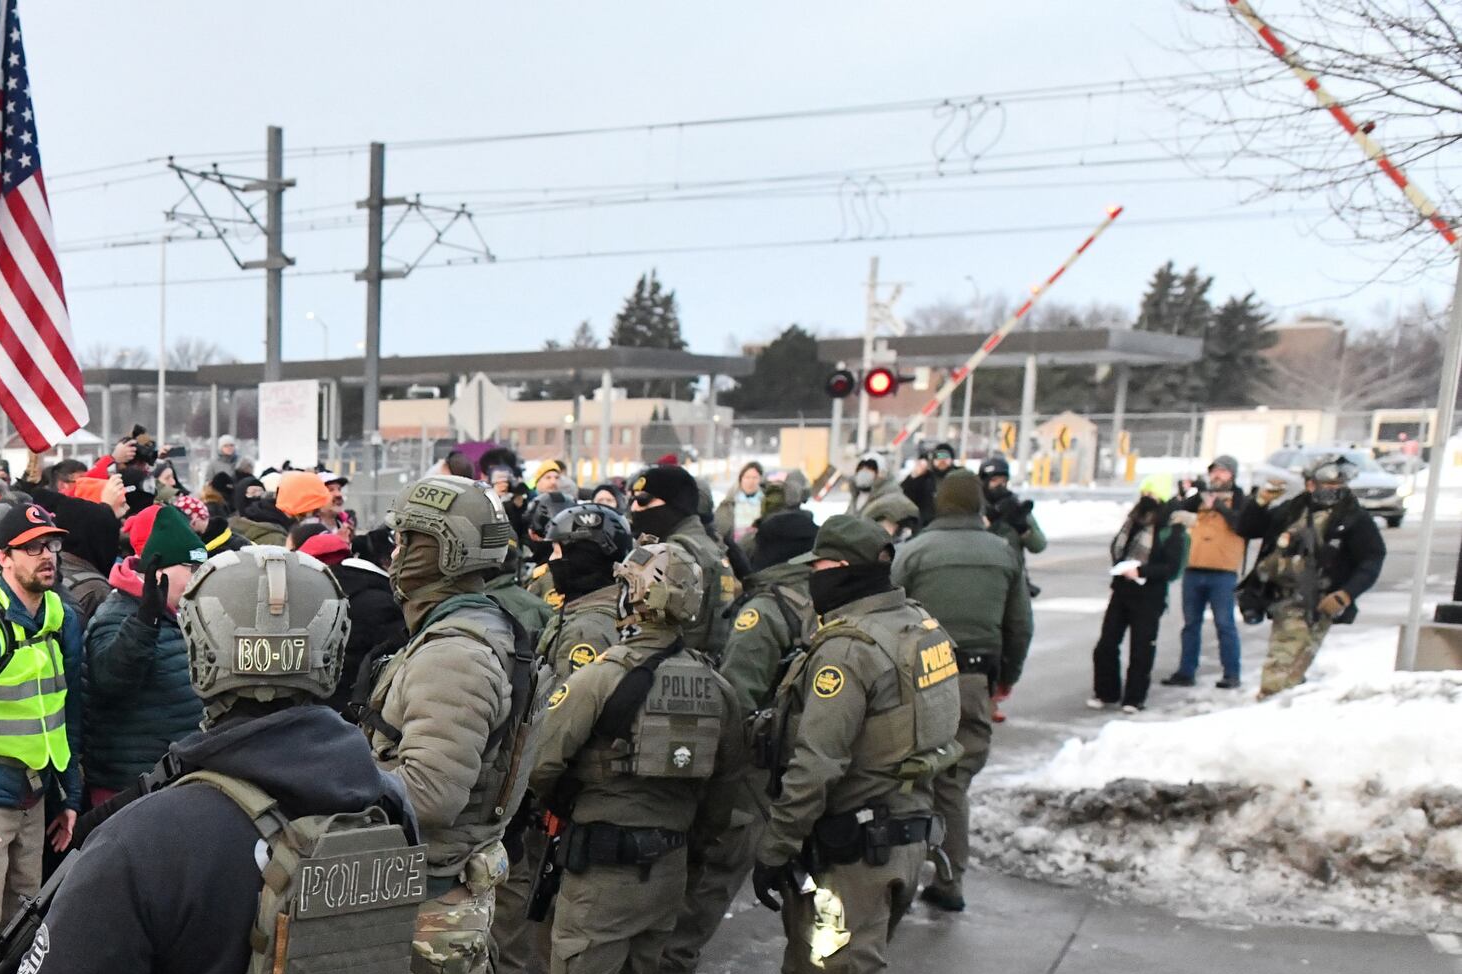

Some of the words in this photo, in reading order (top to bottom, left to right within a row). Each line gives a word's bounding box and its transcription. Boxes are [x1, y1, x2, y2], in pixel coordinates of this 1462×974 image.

[415, 486, 451, 504] SRT
[920, 640, 954, 673] POLICE
[662, 675, 712, 699] POLICE
[300, 852, 426, 912] POLICE
